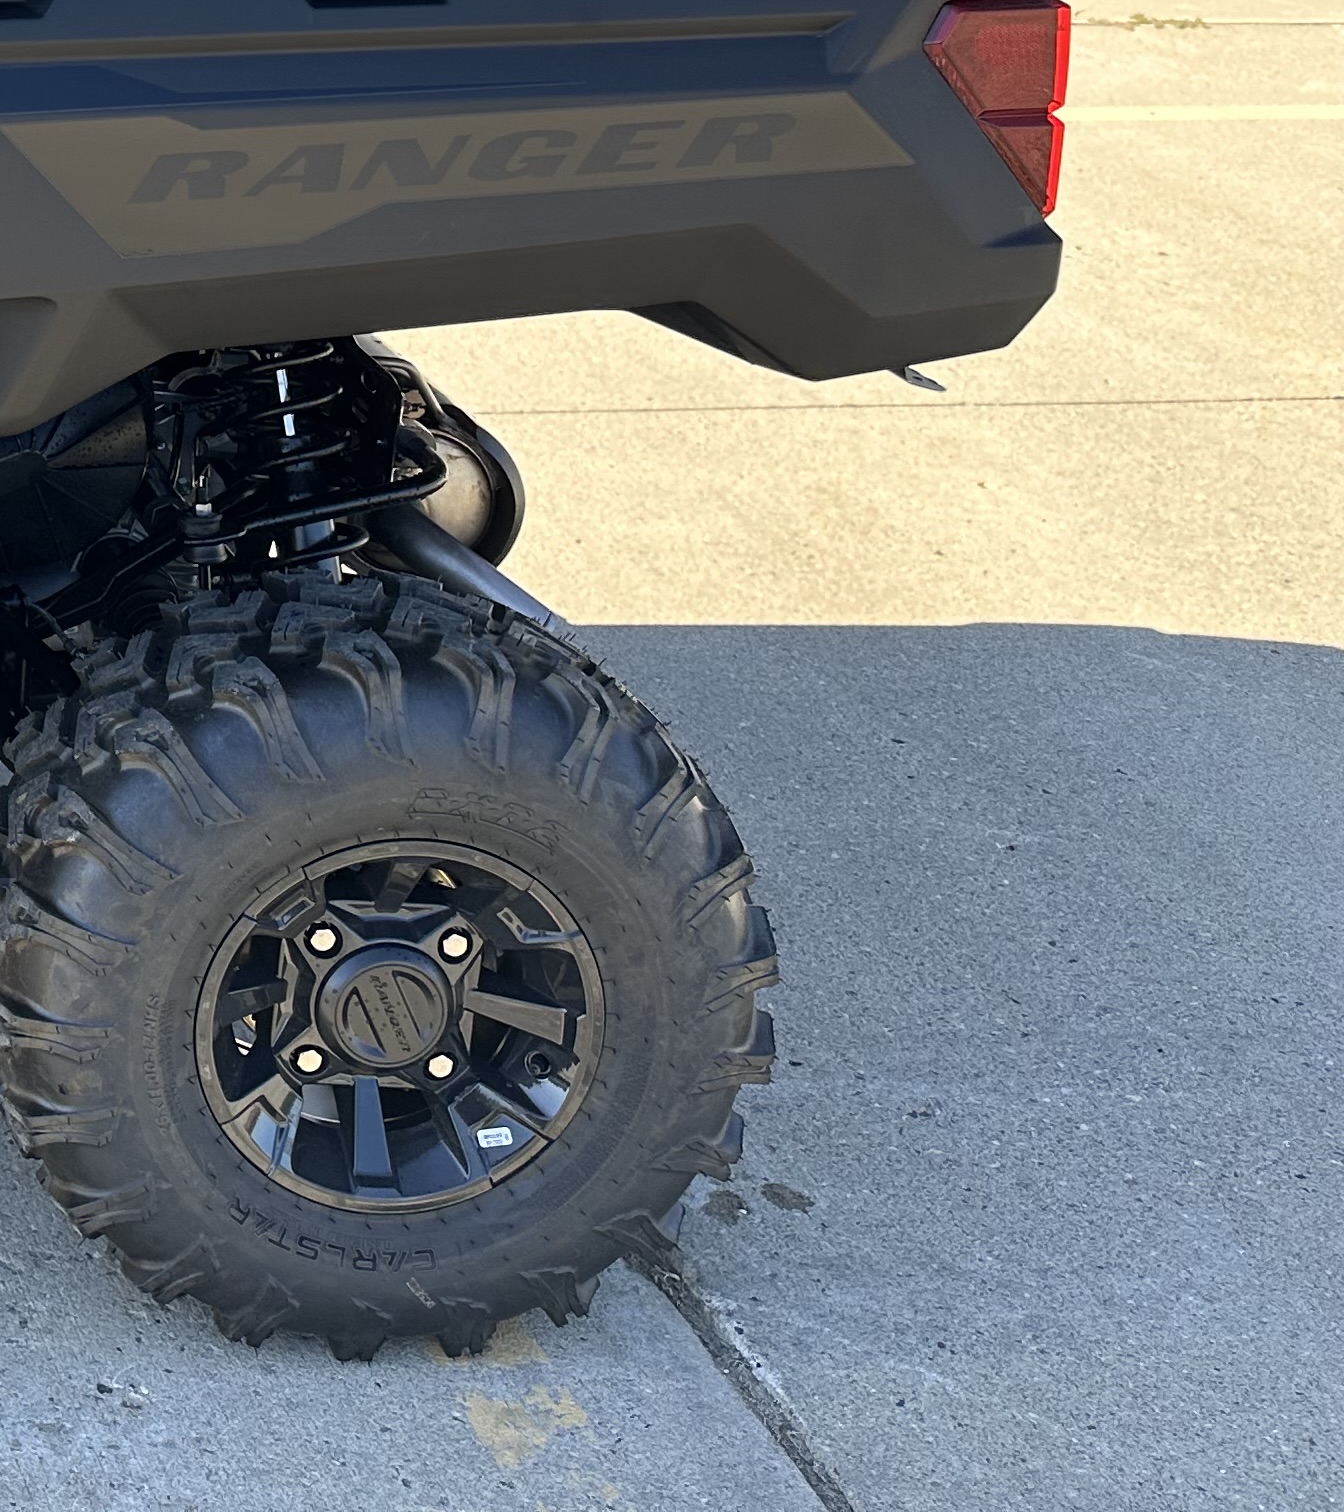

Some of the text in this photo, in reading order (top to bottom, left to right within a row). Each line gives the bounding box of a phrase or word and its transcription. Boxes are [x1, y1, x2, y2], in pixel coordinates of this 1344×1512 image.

[125, 112, 798, 206] RANGER
[369, 974, 411, 1053] RANGER
[226, 1194, 439, 1273] CARLSTAR
